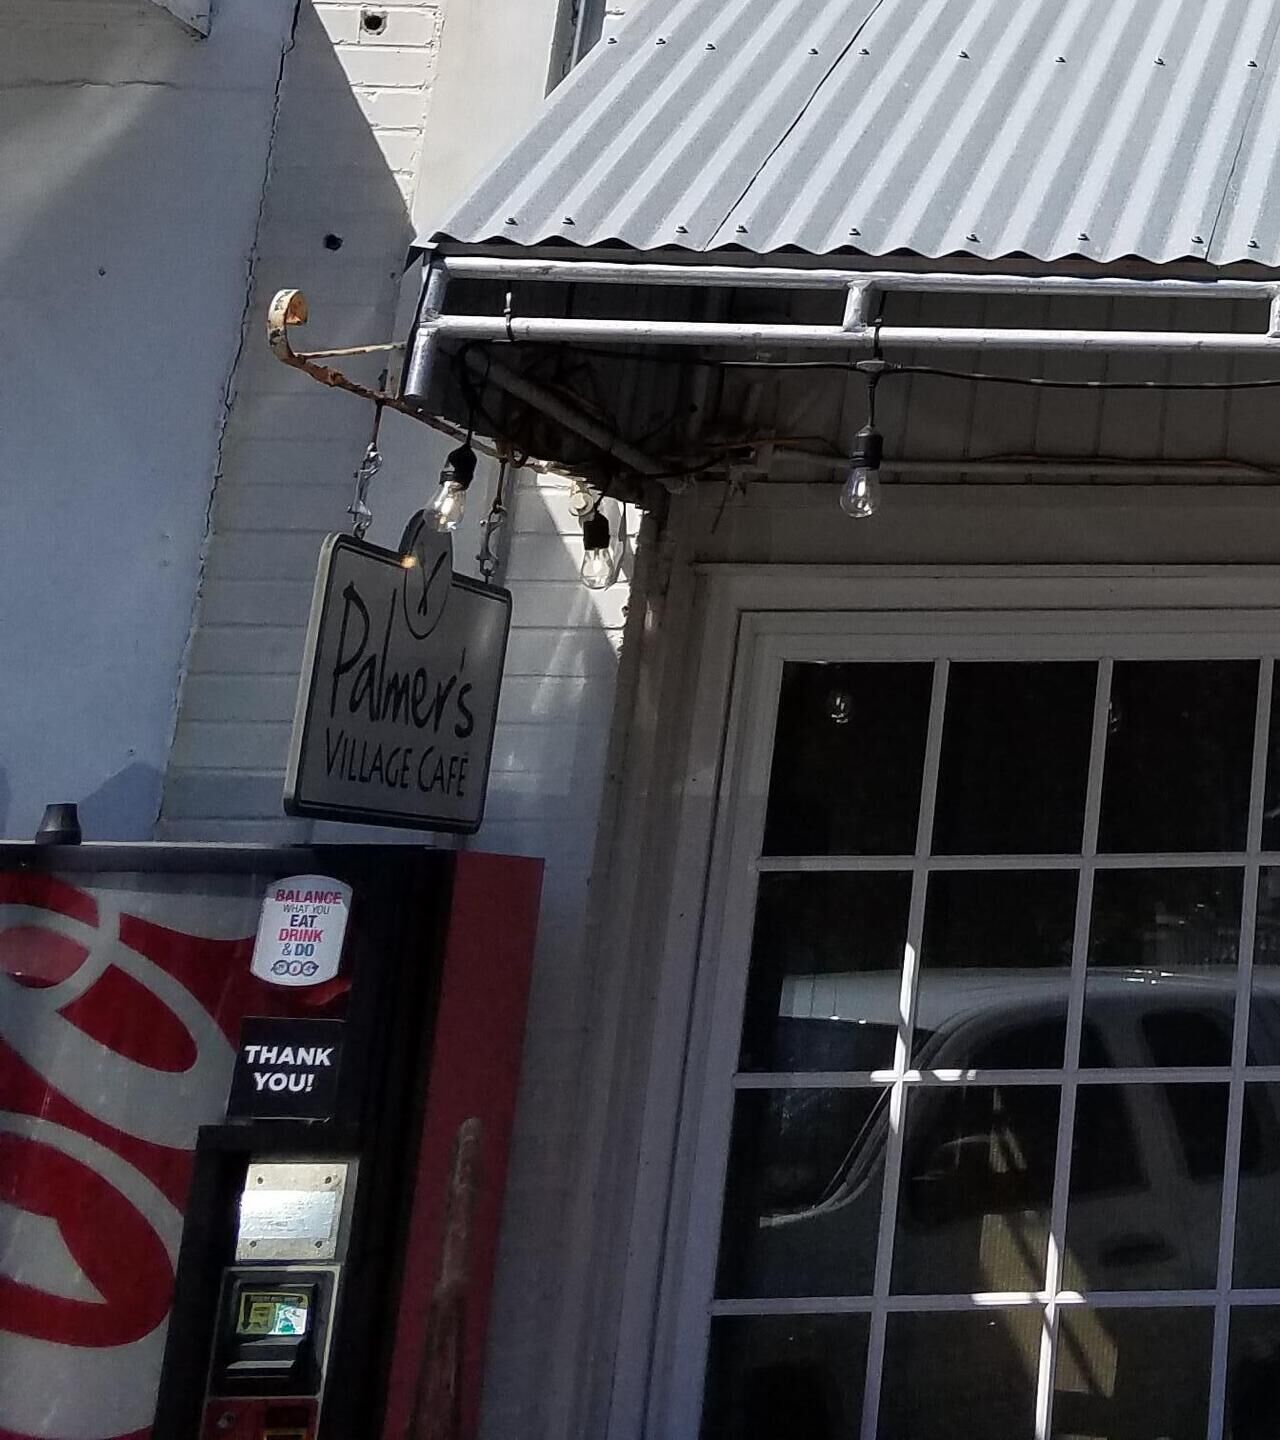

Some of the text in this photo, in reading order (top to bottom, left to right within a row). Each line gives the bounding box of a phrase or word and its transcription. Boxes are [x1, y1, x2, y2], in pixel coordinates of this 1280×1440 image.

[330, 580, 474, 739] Palmer's
[325, 726, 413, 789] VILLAGE
[275, 889, 343, 905] BALANCE
[283, 904, 331, 915] WHAT YOU
[290, 914, 318, 928] EAT
[278, 928, 324, 943] DRINK
[281, 942, 315, 957] & DO
[244, 1045, 335, 1066] THANK
[253, 1072, 315, 1092] YOU!
